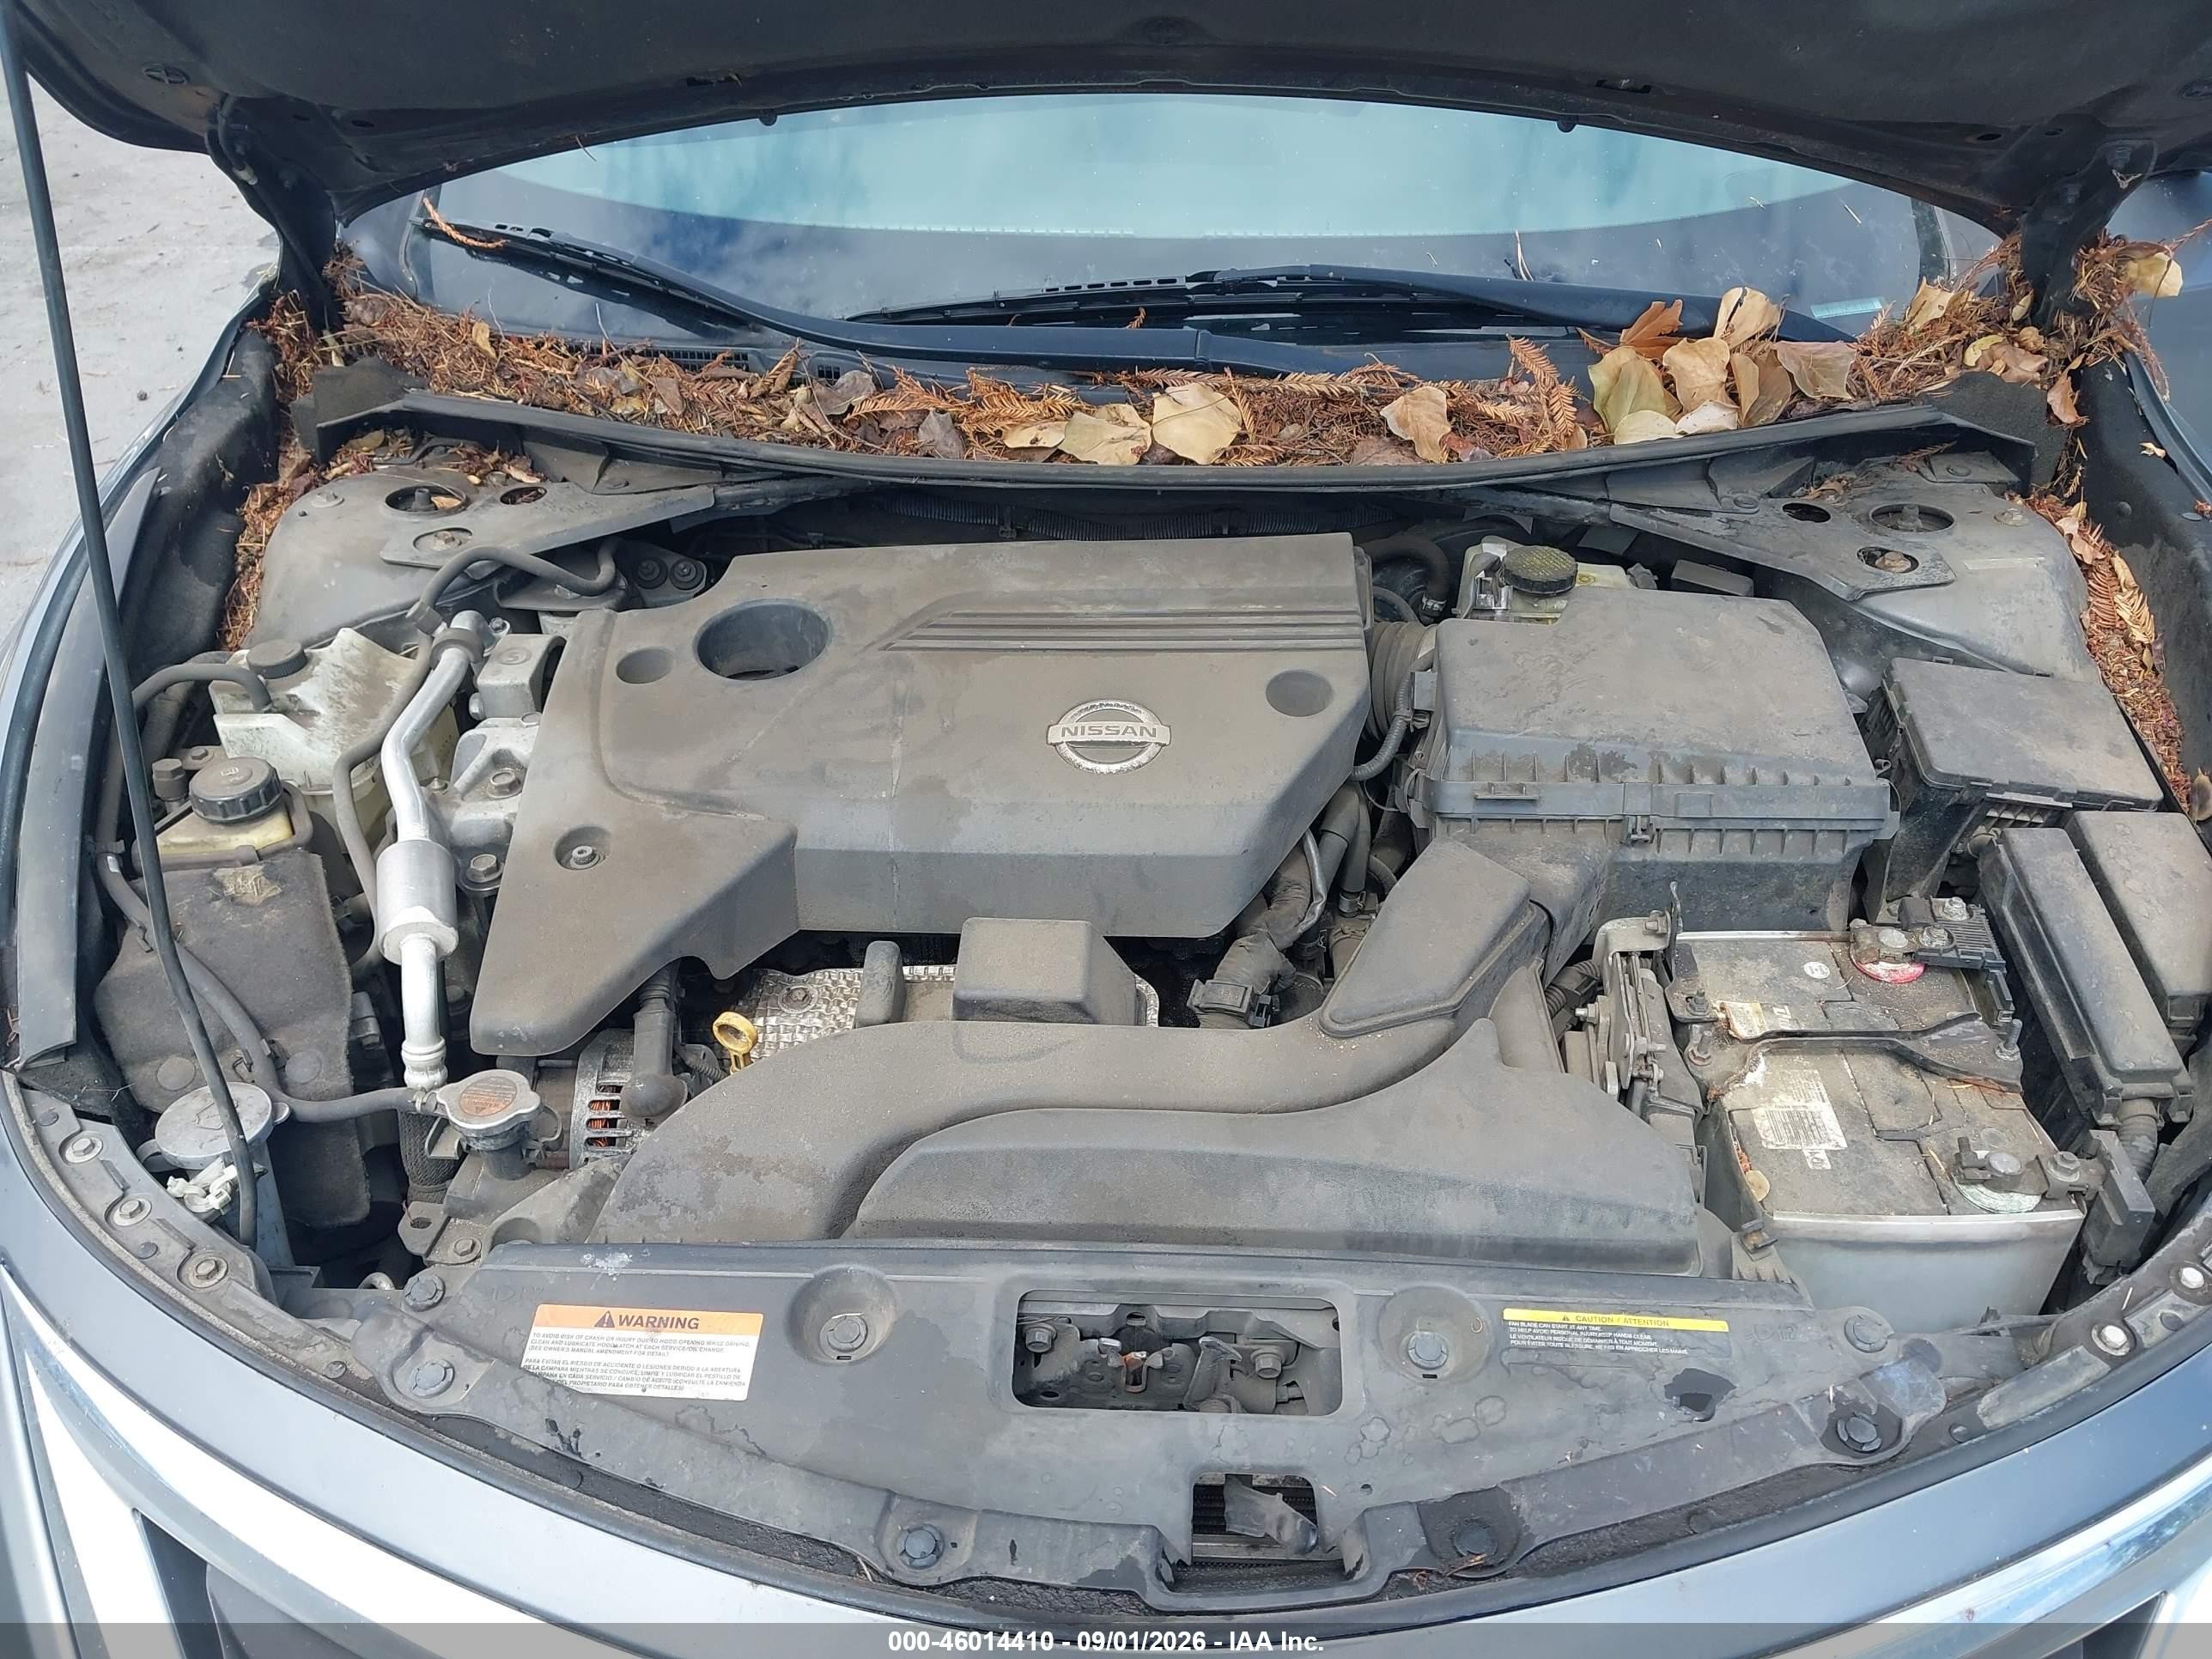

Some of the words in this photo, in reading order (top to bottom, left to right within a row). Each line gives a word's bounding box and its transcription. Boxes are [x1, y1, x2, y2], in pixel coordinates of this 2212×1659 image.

[1061, 726, 1157, 738] NISSAN
[618, 1315, 699, 1329] WARNING
[1575, 1315, 1613, 1323] CAUTION
[1623, 1318, 1669, 1326] ATTENTION
